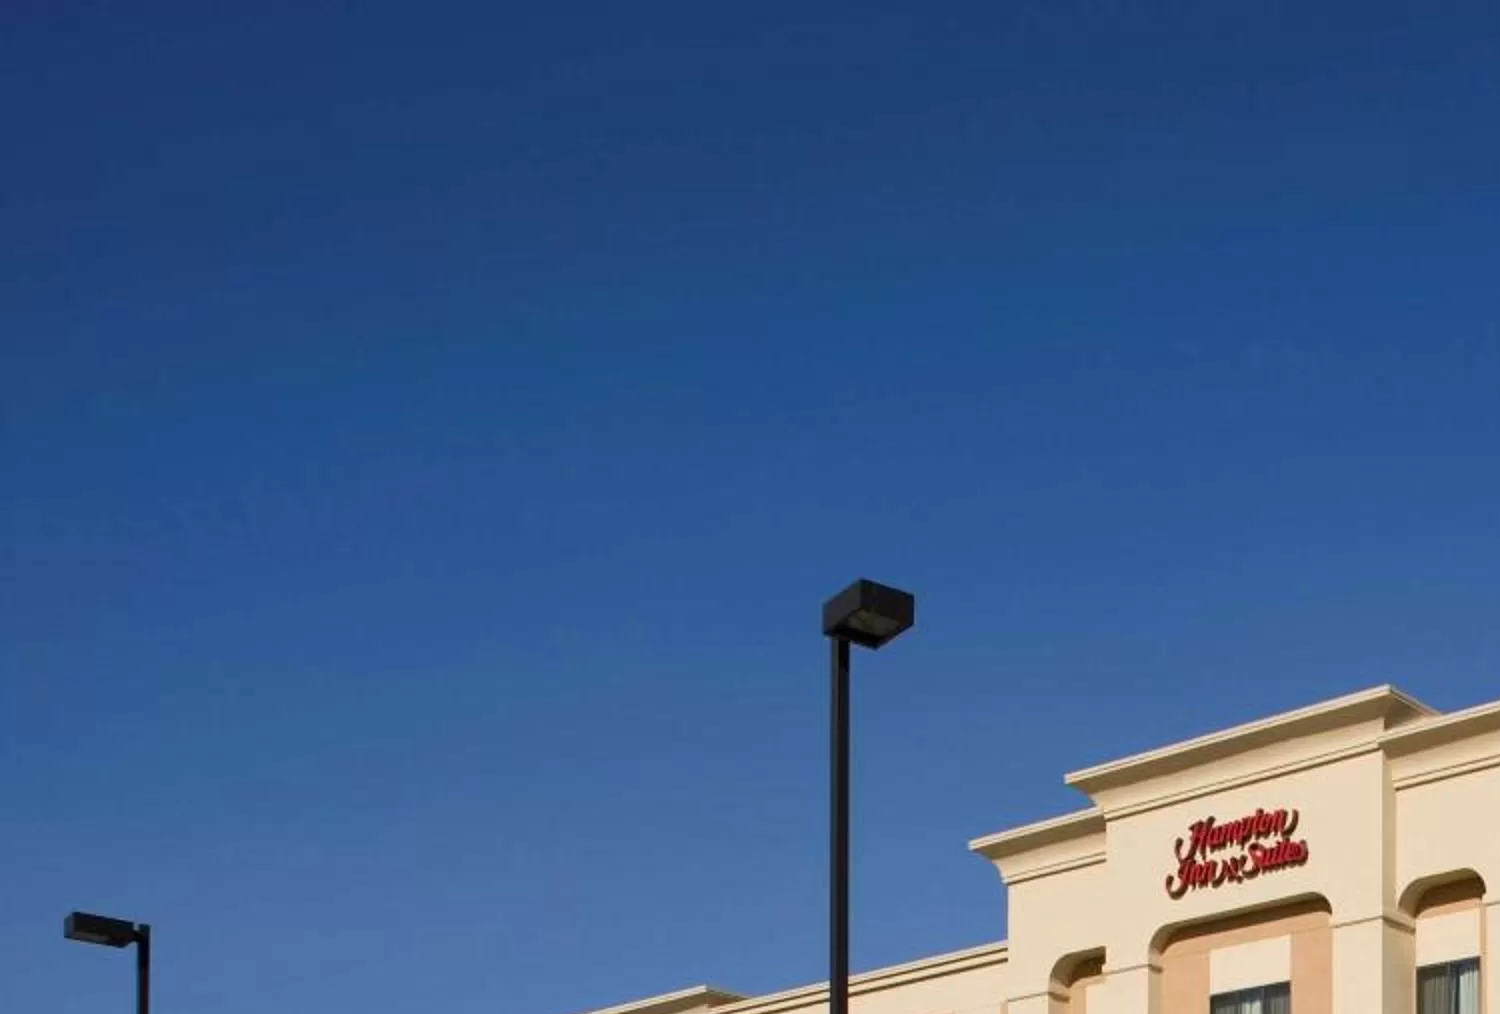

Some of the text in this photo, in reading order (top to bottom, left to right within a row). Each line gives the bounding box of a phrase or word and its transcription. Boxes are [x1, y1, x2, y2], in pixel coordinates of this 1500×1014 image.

[1175, 808, 1299, 861] Hampton
[1166, 859, 1228, 900] Inn
[1242, 838, 1309, 880] Suites
